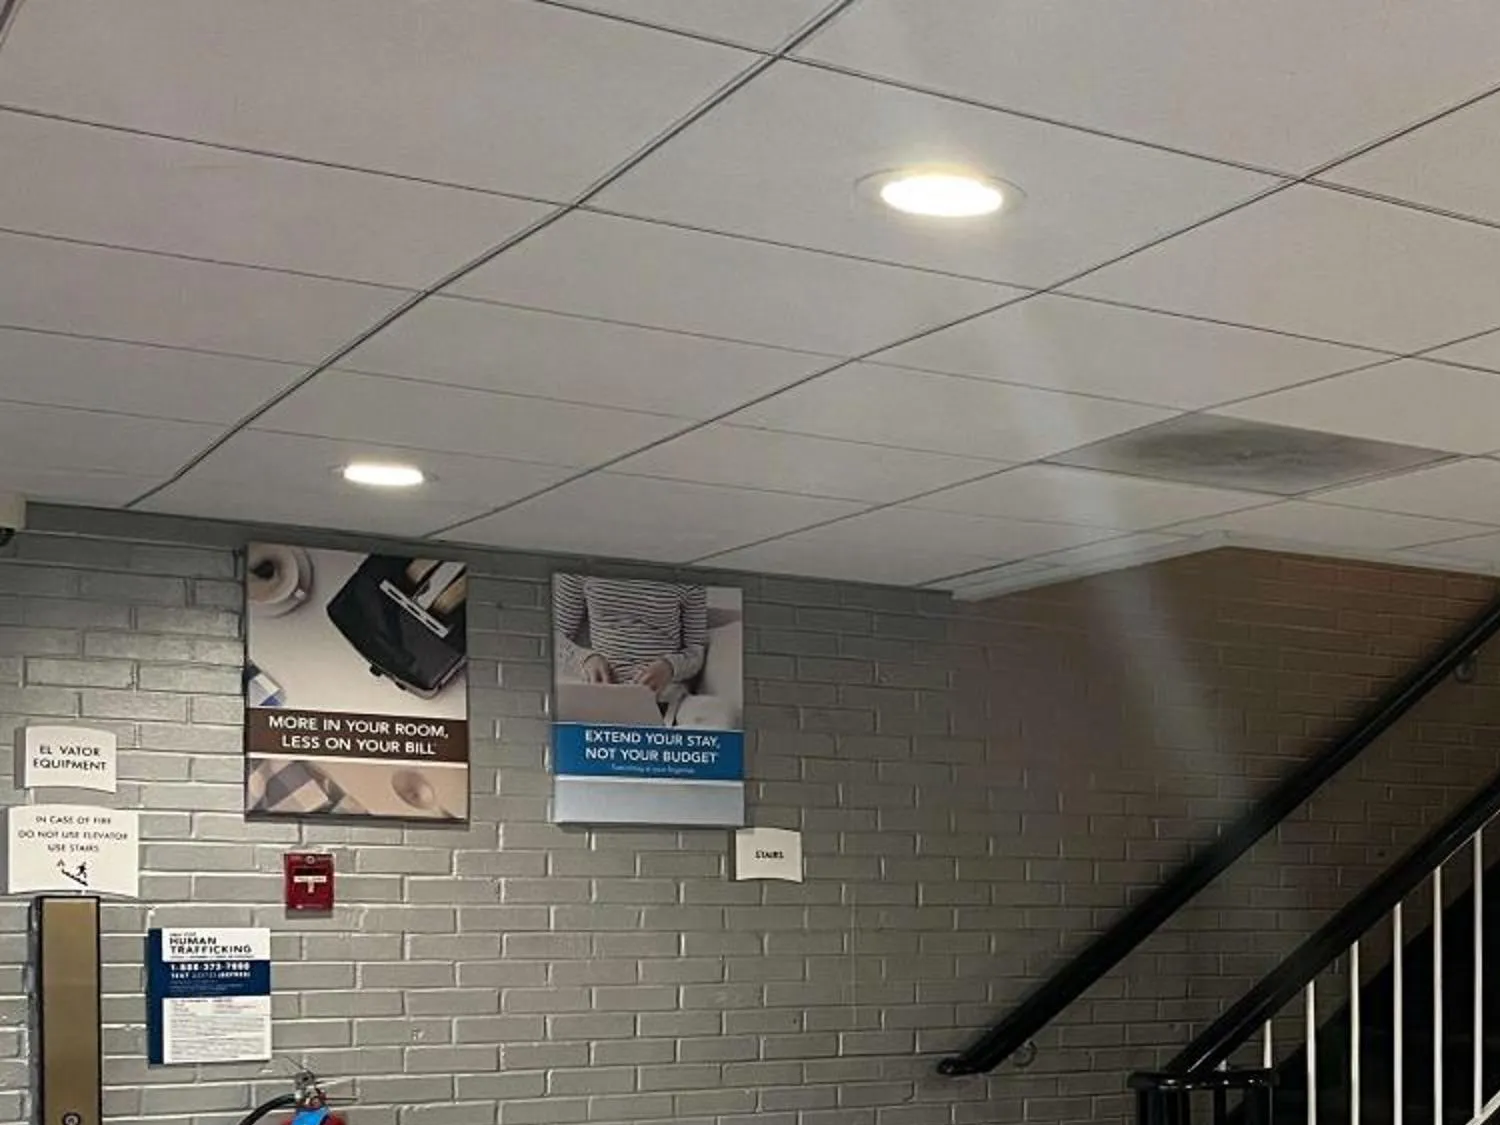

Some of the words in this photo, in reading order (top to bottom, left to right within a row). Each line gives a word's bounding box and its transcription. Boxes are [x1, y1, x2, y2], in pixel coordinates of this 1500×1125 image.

[269, 715, 318, 731] MORE
[323, 719, 341, 731] IN
[344, 720, 390, 735] YOUR
[395, 724, 449, 739] ROOM,
[585, 729, 641, 744] EXTEND
[645, 733, 683, 746] YOUR
[687, 736, 720, 749] STAY,
[282, 735, 320, 749] LESS
[325, 737, 351, 750] ON
[356, 739, 401, 753] YOUR
[405, 742, 436, 755] BILL
[585, 747, 617, 760] NOT
[620, 749, 659, 761] YOUR
[663, 751, 718, 763] BUDGET
[33, 759, 107, 771] EQUIPMENT
[36, 816, 47, 824] IN
[50, 816, 73, 824] CASE
[76, 816, 89, 825] OF
[93, 816, 112, 825] FIRE
[18, 830, 35, 839] DO
[37, 831, 60, 839] NOT
[83, 831, 128, 841] ELEVATOR
[48, 844, 65, 853] USE
[69, 844, 100, 853] STAIRS
[169, 937, 217, 945] HUMAN
[170, 945, 253, 954] TRAFFICKING
